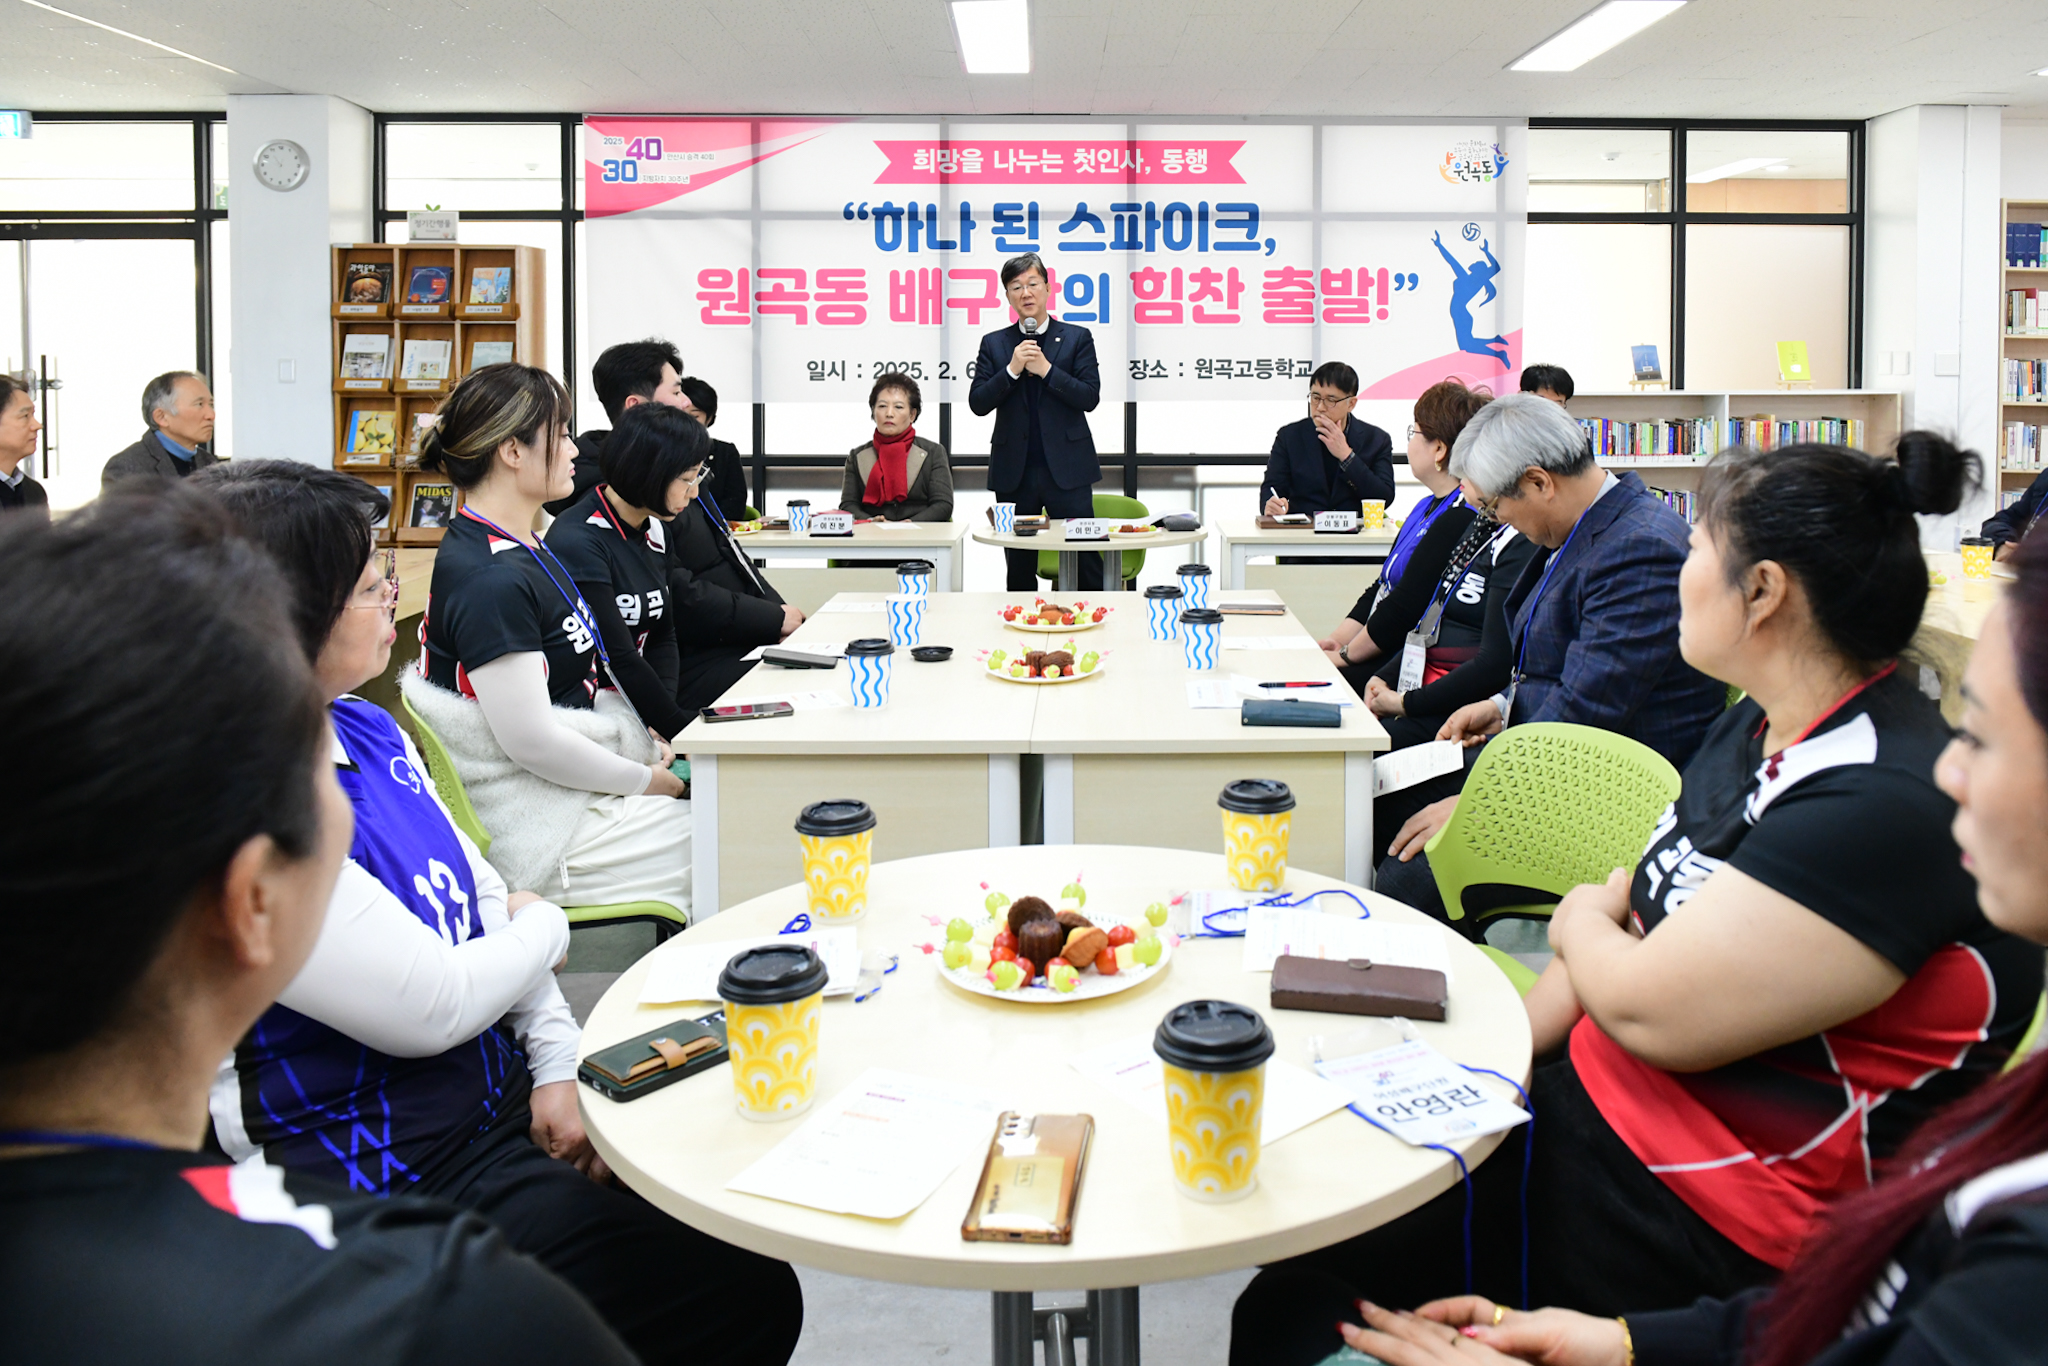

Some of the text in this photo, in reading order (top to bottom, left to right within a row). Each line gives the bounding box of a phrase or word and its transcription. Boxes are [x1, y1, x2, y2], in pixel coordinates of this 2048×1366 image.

[603, 137, 623, 146] 2025
[626, 137, 662, 160] 40
[603, 159, 638, 182] 30
[912, 148, 1208, 176] 희망을 나누는 첫인사, 동행
[1453, 160, 1494, 182] 원곡동
[842, 200, 1277, 257] “하나 된 스파이크,
[696, 265, 1420, 326] 원곡동 배구의 힘찬 출발!”
[806, 360, 847, 382] 일시
[938, 361, 957, 381] 2.
[1128, 359, 1169, 381] 장소
[1194, 358, 1314, 380] 원곡고등학교
[416, 486, 452, 497] MIDAS
[413, 857, 472, 948] 13
[1377, 1084, 1489, 1123] 안영란
